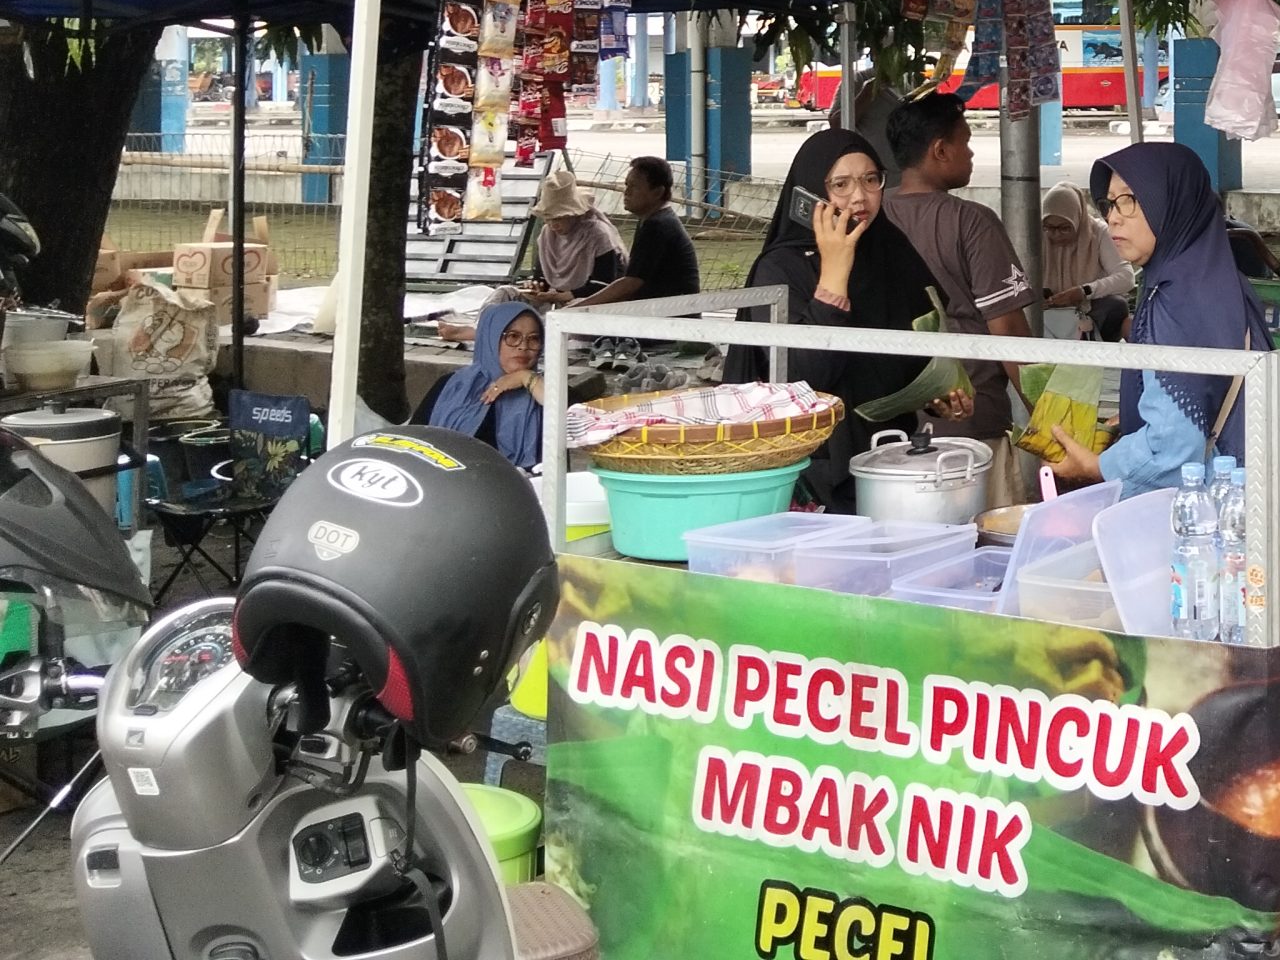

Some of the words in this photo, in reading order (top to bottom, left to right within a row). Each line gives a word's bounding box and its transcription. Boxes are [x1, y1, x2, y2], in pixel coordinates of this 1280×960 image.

[252, 406, 292, 424] speeds
[314, 525, 352, 548] DOT
[578, 632, 716, 711] NASI
[733, 656, 912, 746] PECEL
[930, 686, 1190, 799] PINCUK
[702, 758, 890, 856] MBAK
[907, 796, 1023, 885] NIK
